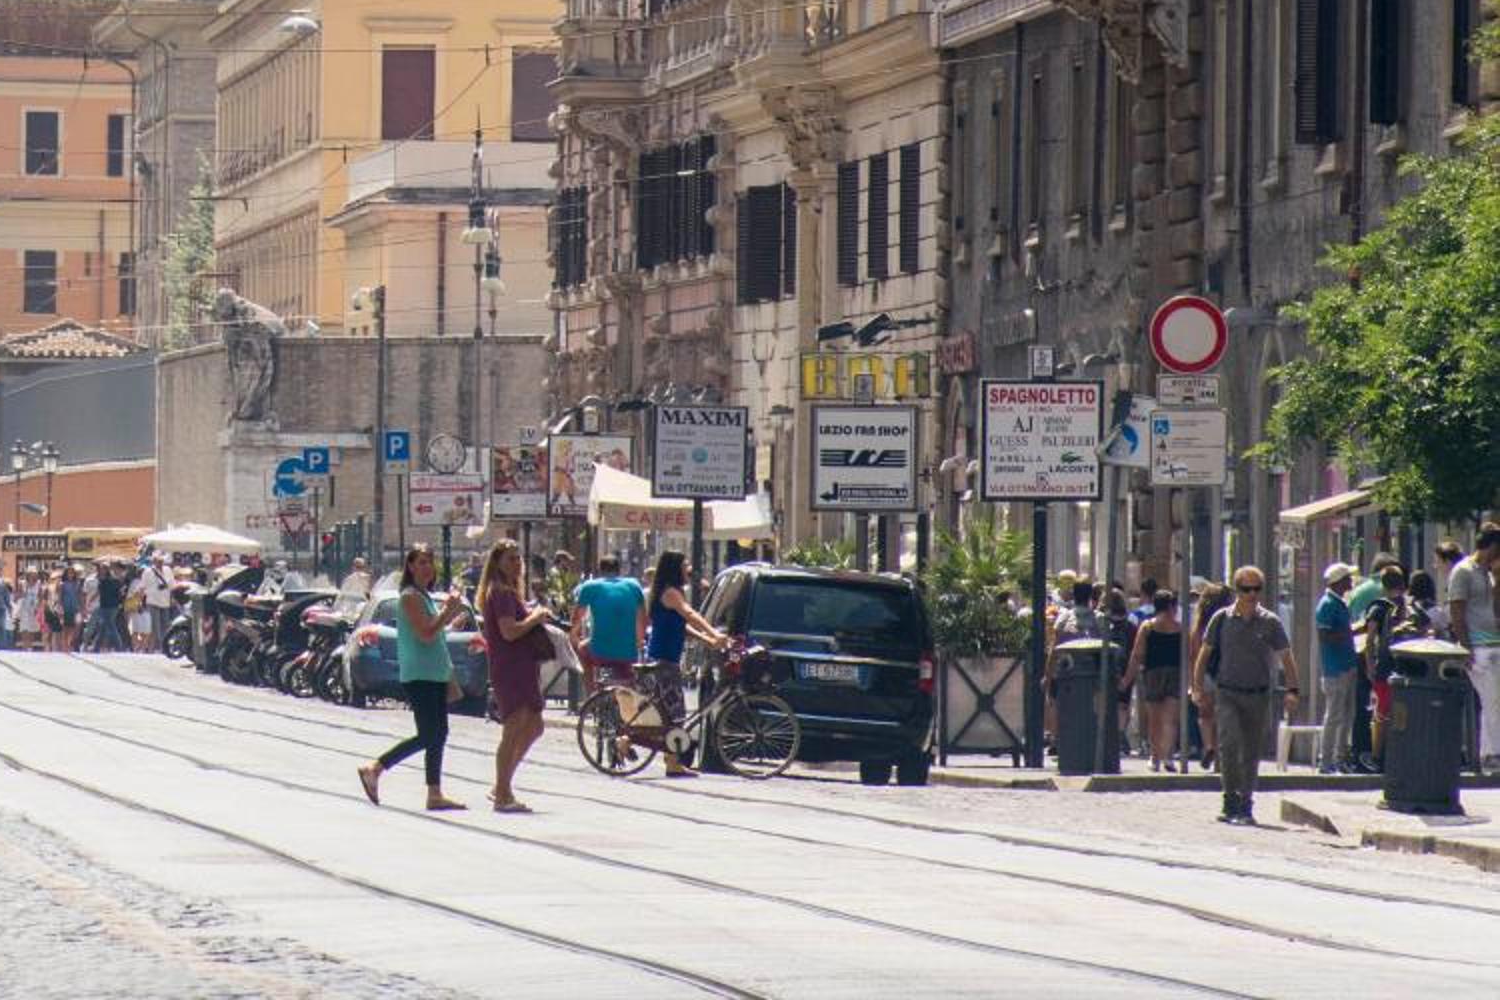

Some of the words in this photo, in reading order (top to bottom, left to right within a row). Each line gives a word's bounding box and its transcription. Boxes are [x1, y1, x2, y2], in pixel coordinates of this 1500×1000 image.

[989, 387, 1096, 405] SPAGNOLETTO
[661, 409, 742, 427] MAXIM
[877, 425, 909, 436] SHOP
[389, 435, 404, 456] P
[308, 452, 324, 470] P
[1049, 465, 1095, 473] LACOSTE
